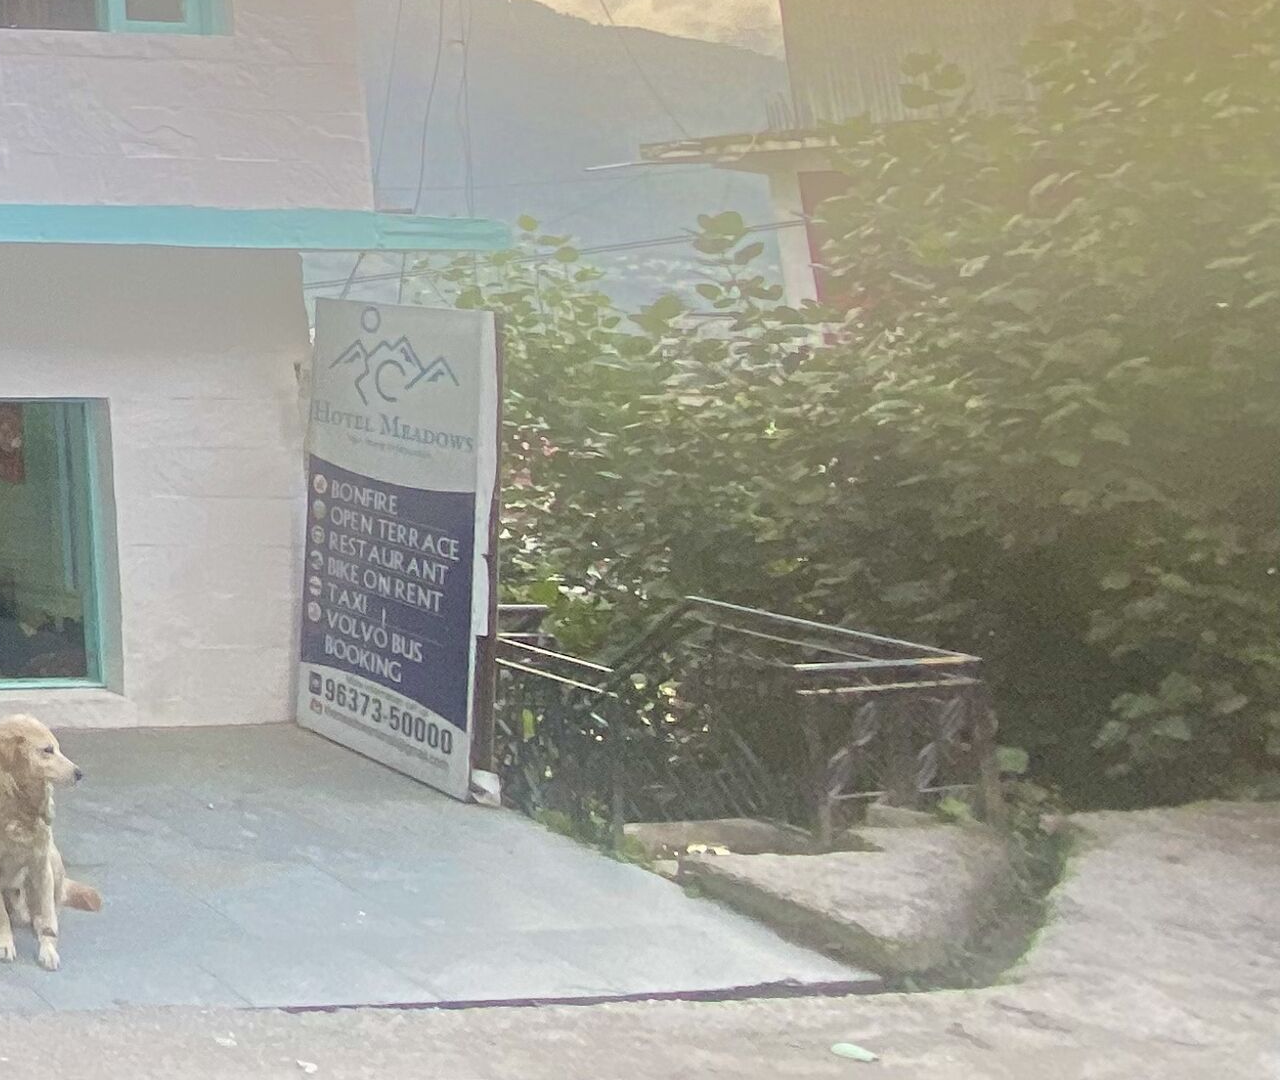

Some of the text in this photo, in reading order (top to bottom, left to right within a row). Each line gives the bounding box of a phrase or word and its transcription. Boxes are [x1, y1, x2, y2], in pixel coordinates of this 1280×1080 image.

[330, 480, 398, 515] BONFIRE
[328, 531, 449, 585] RESTAURANT
[330, 506, 460, 561] OPEN TERRACE
[327, 556, 444, 612] BIKE ON RENT
[327, 583, 368, 614] TAXI
[324, 634, 402, 683] BOOKING
[326, 609, 423, 663] VOLVO BUS
[324, 678, 453, 755] 96373-50000
